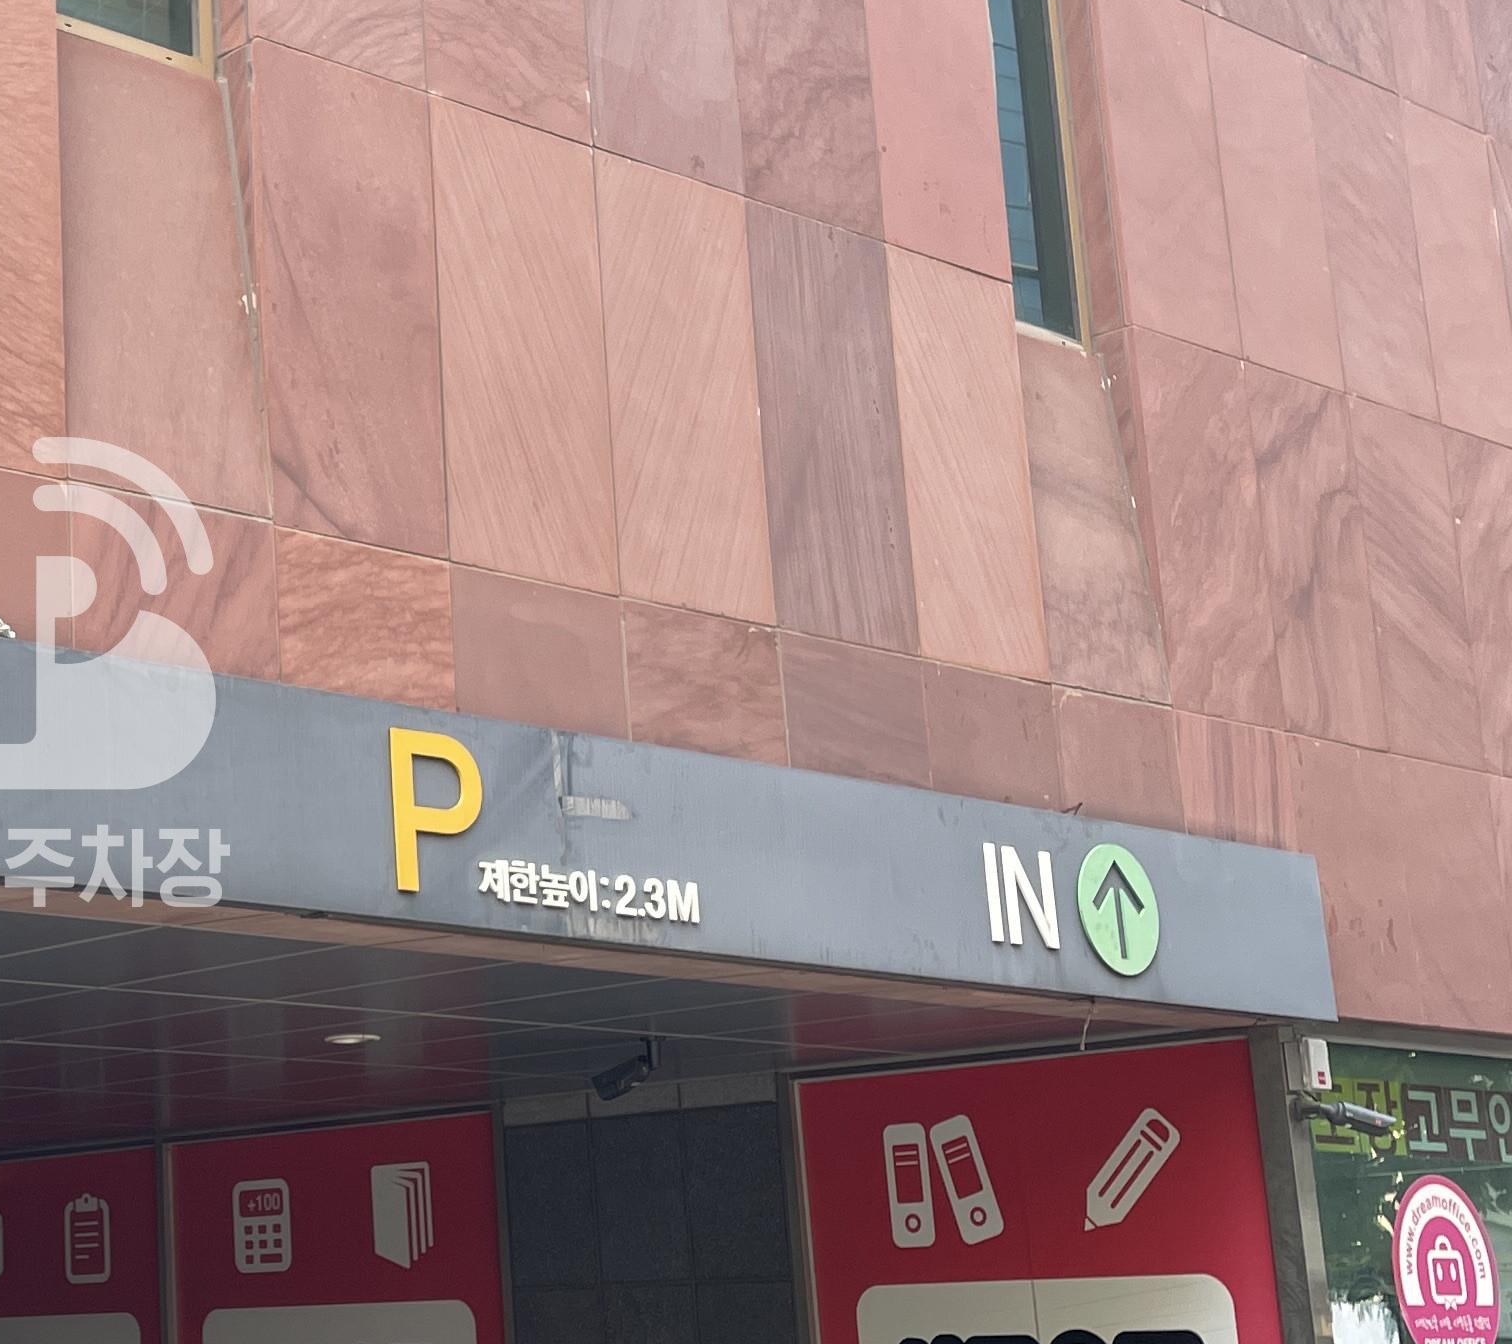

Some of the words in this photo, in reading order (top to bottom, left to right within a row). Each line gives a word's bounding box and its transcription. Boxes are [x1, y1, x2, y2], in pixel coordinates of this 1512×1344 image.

[388, 726, 485, 893] P
[478, 858, 701, 925] 제한높이:2.3M
[981, 842, 1061, 951] IN
[1405, 1193, 1487, 1280] www.dreamoffice.com
